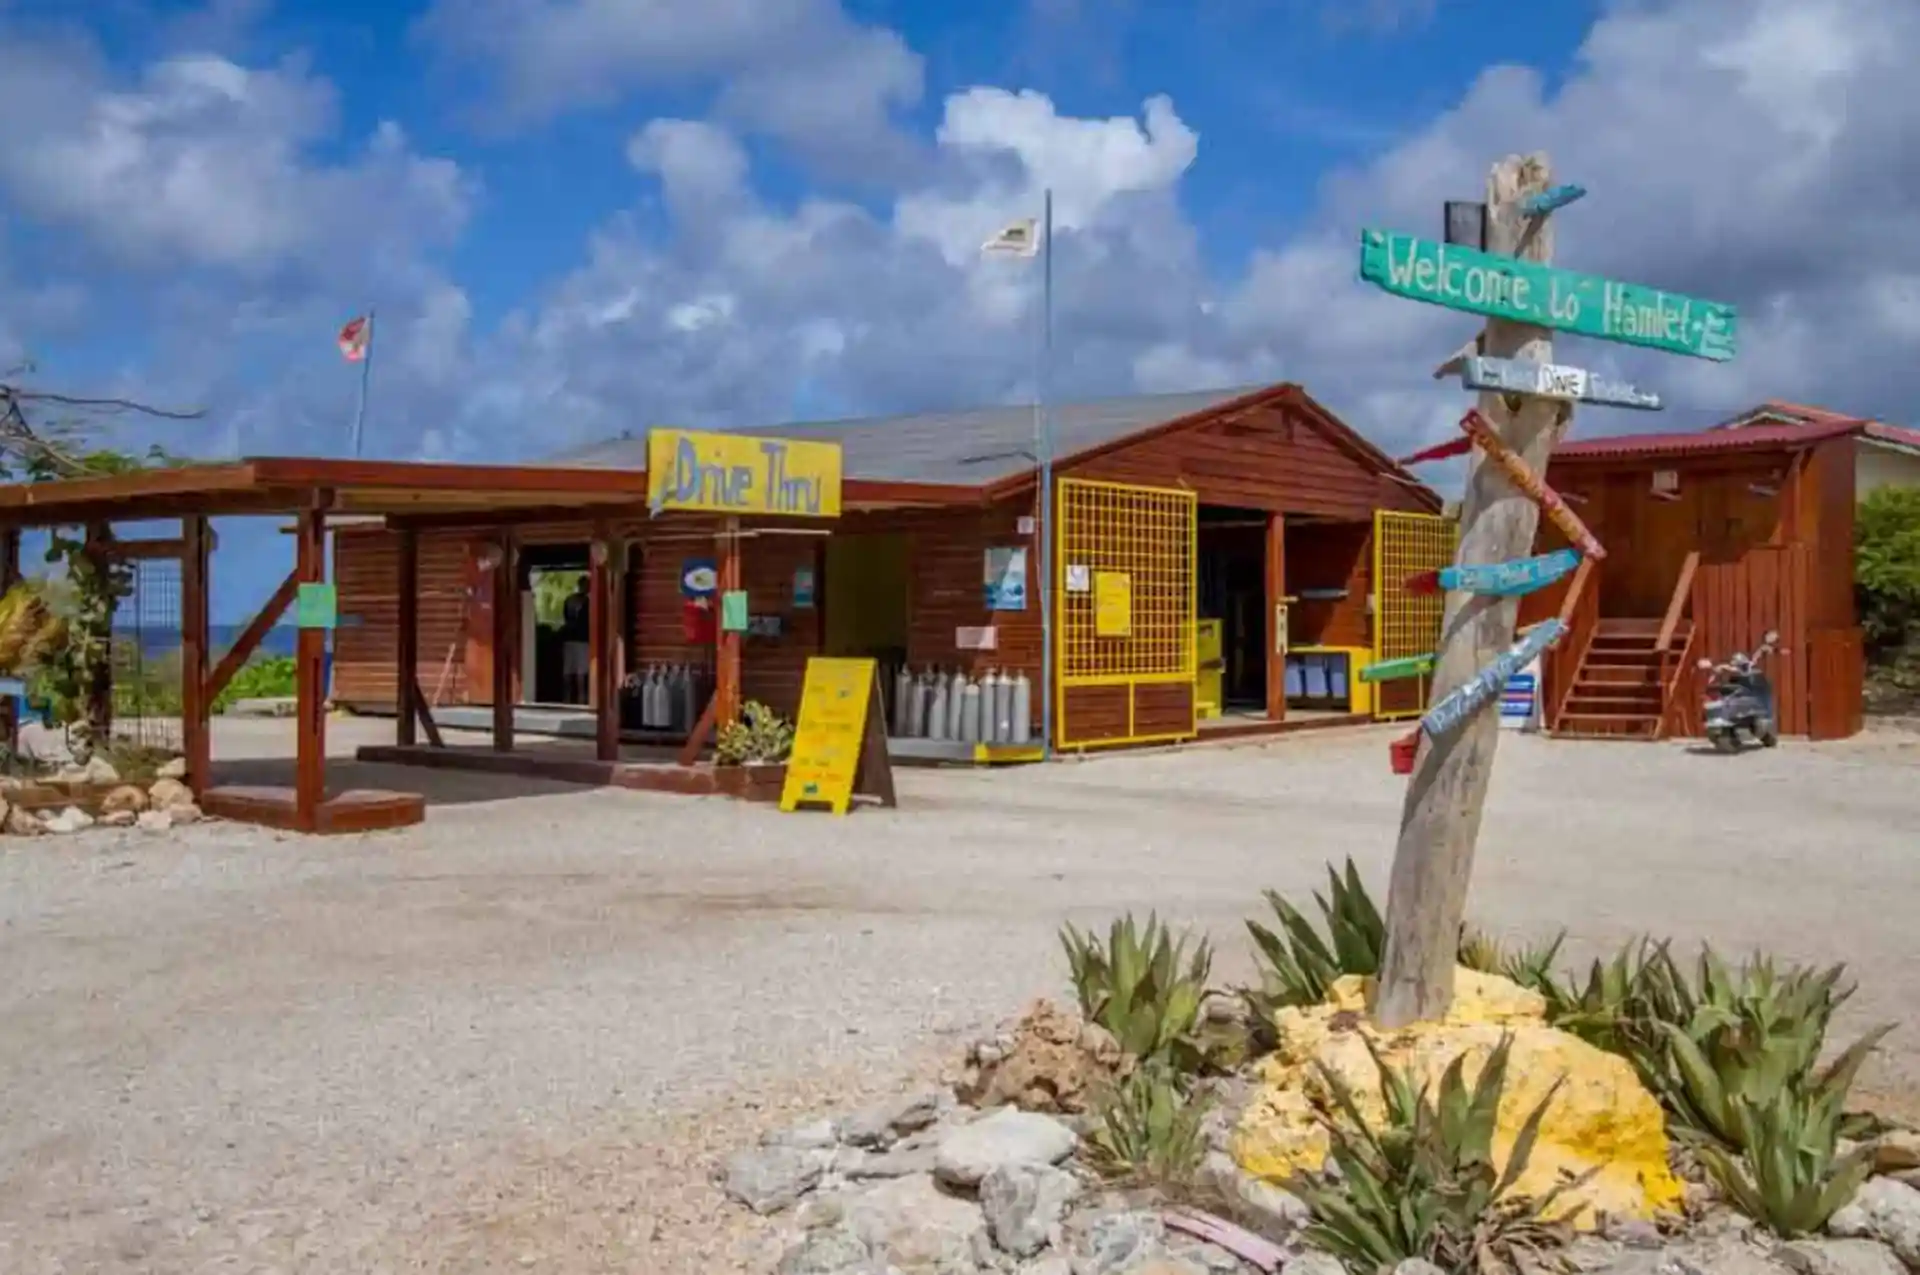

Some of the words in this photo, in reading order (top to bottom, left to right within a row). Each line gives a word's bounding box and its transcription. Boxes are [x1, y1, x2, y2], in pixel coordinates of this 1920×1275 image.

[1387, 235, 1532, 311] Welcome
[1550, 278, 1580, 321] to
[1604, 282, 1691, 345] Hamlet
[676, 437, 752, 505] Drive
[760, 441, 821, 513] Thru
